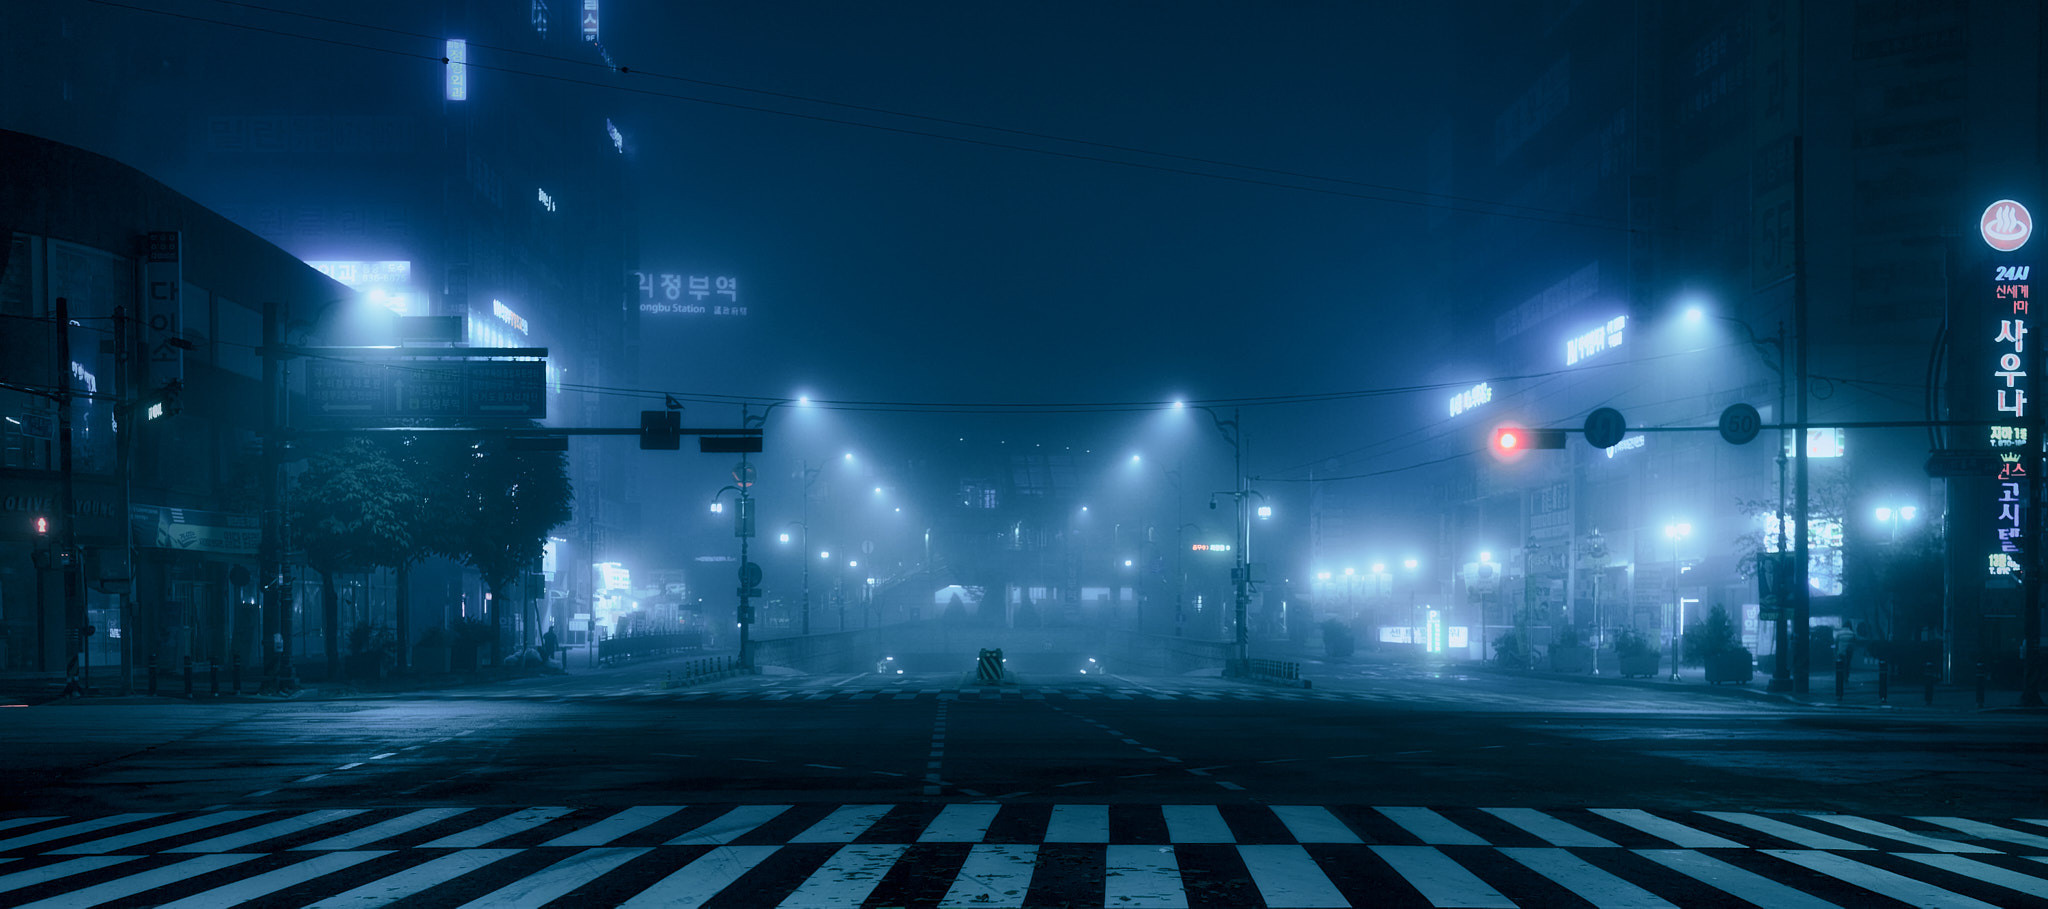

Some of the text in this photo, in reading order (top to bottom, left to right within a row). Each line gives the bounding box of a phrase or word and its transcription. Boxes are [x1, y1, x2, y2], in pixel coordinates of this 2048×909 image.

[1995, 266, 2030, 281] 24시
[1996, 284, 2029, 299] 신세계
[672, 303, 706, 313] Station
[151, 281, 178, 362] 다이소
[1995, 319, 2028, 417] 사우나
[1728, 415, 1752, 433] 50
[1990, 426, 2013, 440] 지하
[5, 496, 52, 512] OLIVE
[1998, 482, 2020, 552] 고시텔
